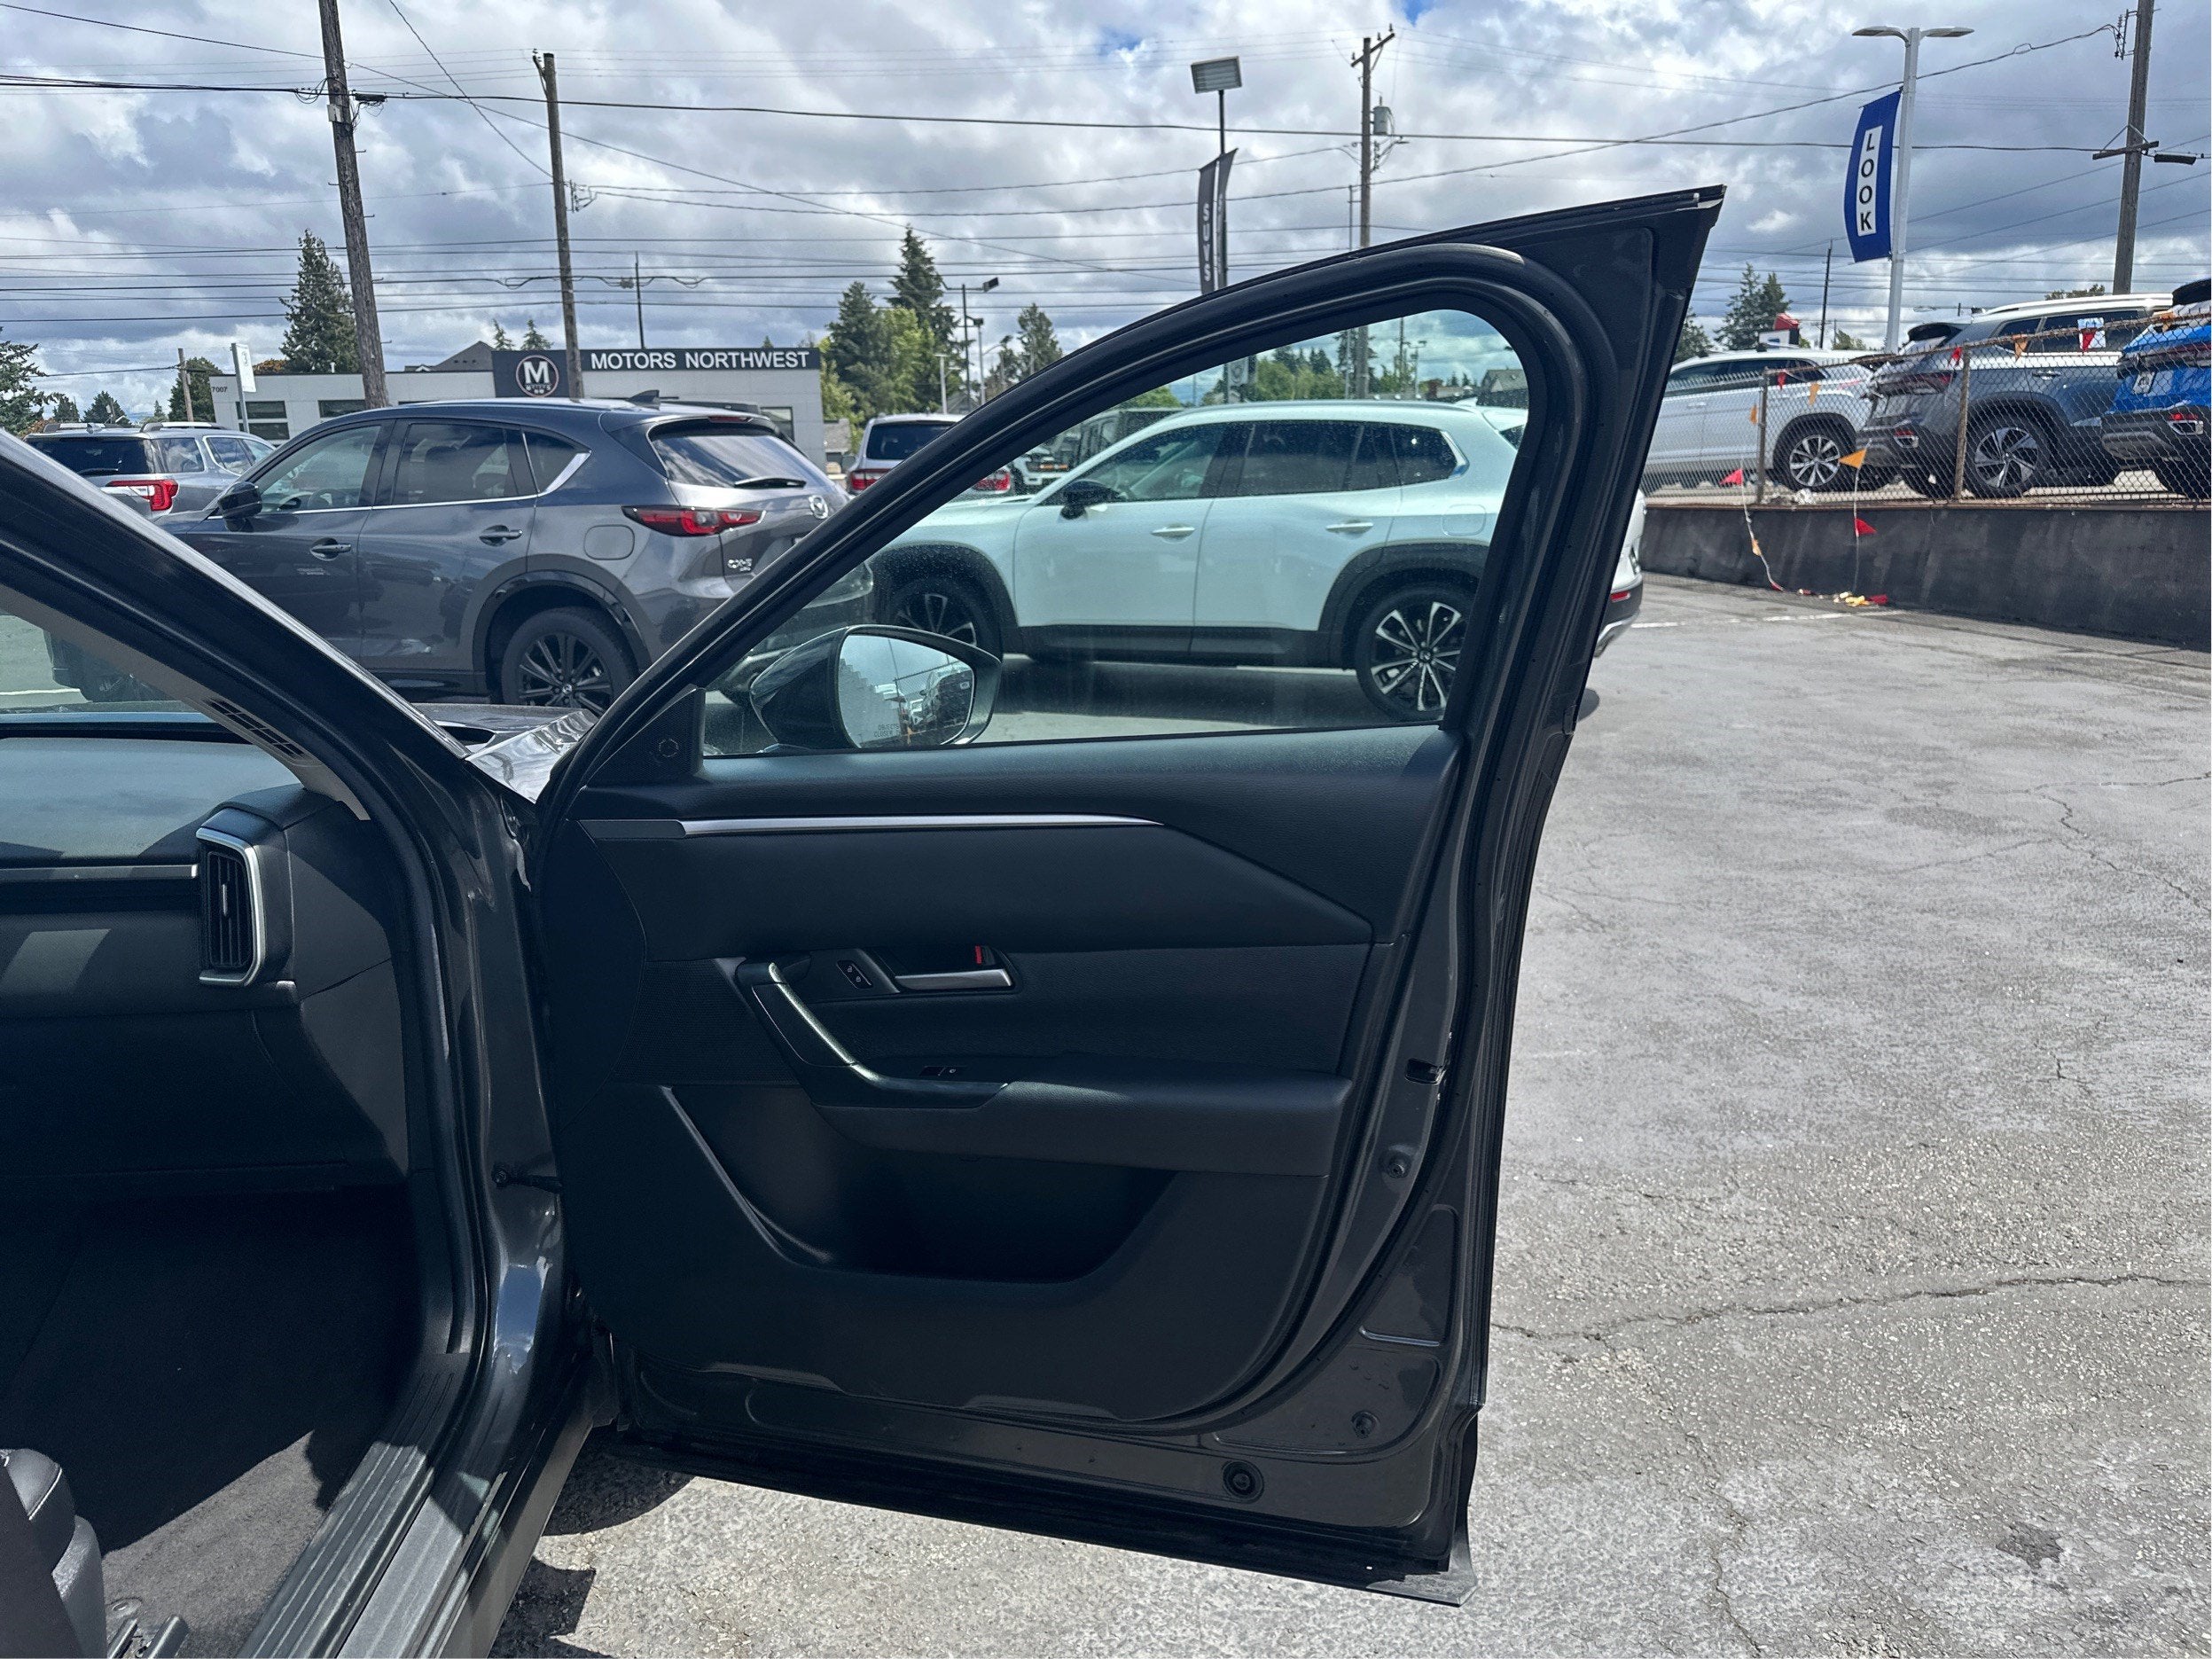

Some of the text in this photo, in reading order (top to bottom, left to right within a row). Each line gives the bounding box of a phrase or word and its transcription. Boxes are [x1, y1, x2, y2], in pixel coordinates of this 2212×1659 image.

[1859, 133, 1875, 231] LOOK
[1202, 203, 1211, 282] SUVS
[523, 361, 550, 383] M
[591, 350, 809, 370] MOTORS NORTHWEST
